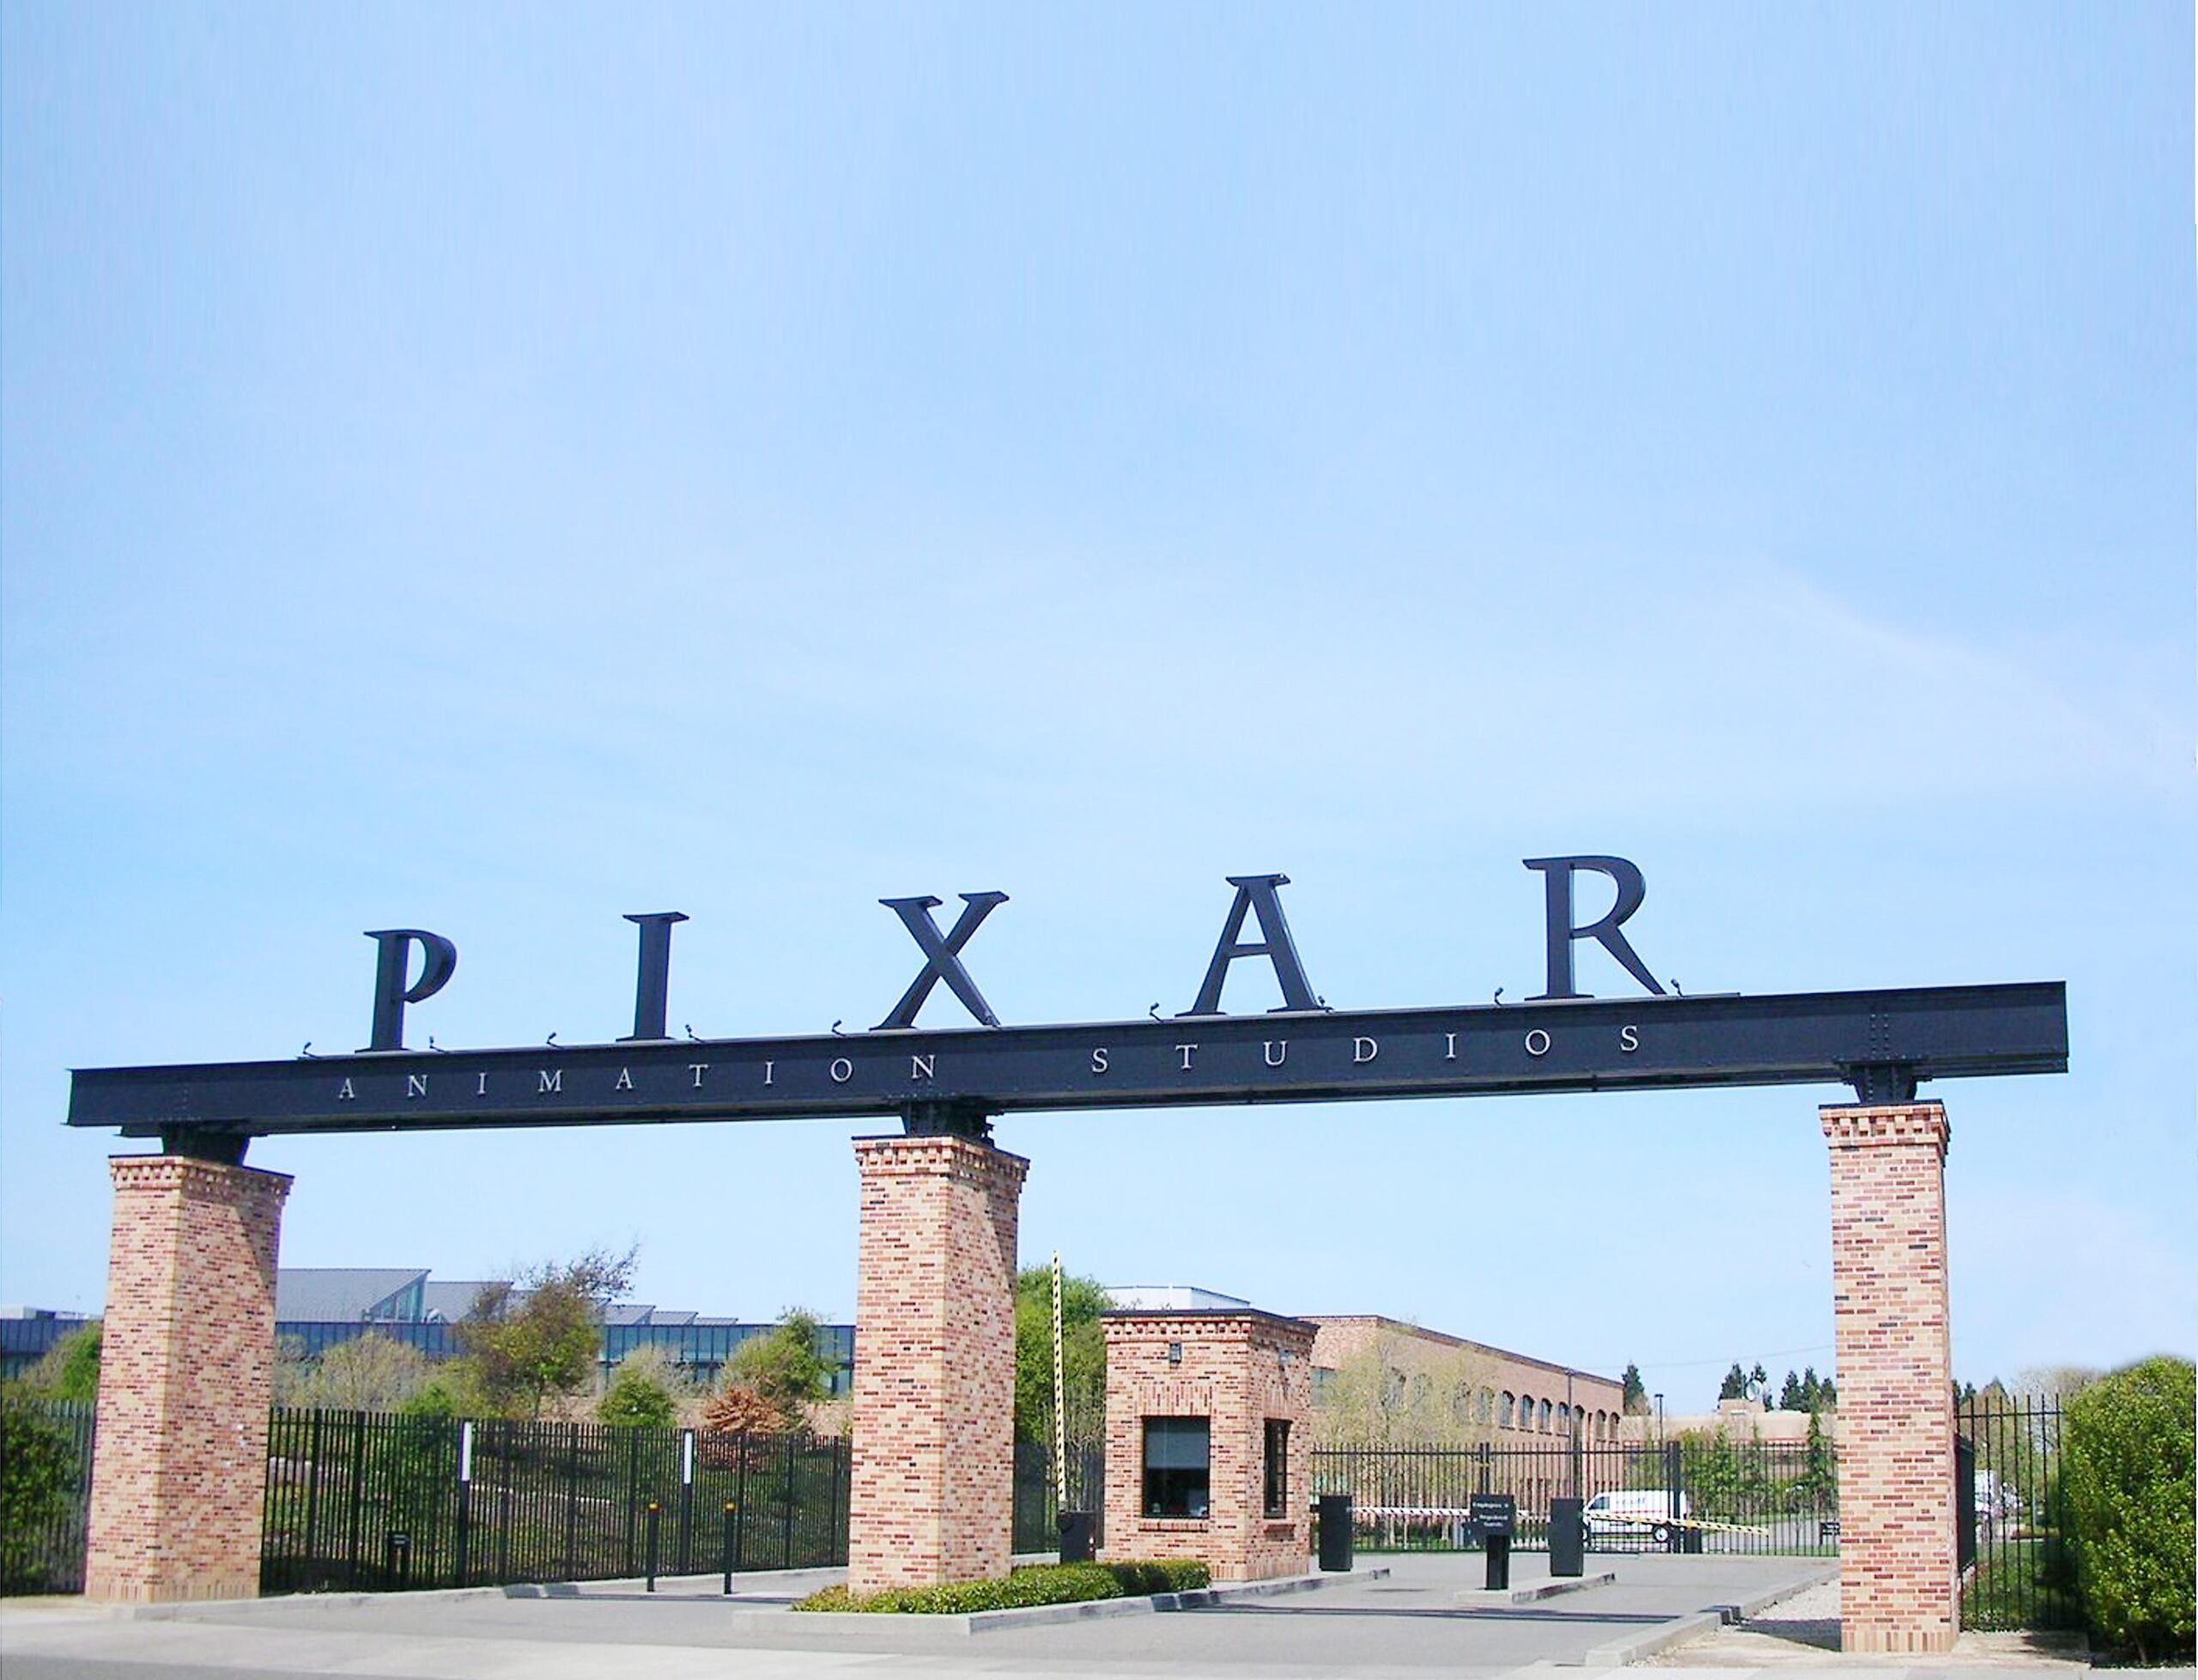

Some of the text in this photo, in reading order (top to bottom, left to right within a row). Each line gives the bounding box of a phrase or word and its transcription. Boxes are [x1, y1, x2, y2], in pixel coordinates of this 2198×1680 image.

[355, 855, 1667, 1053] PIXAR
[339, 1023, 1641, 1100] ANIMATION STUDIOS
